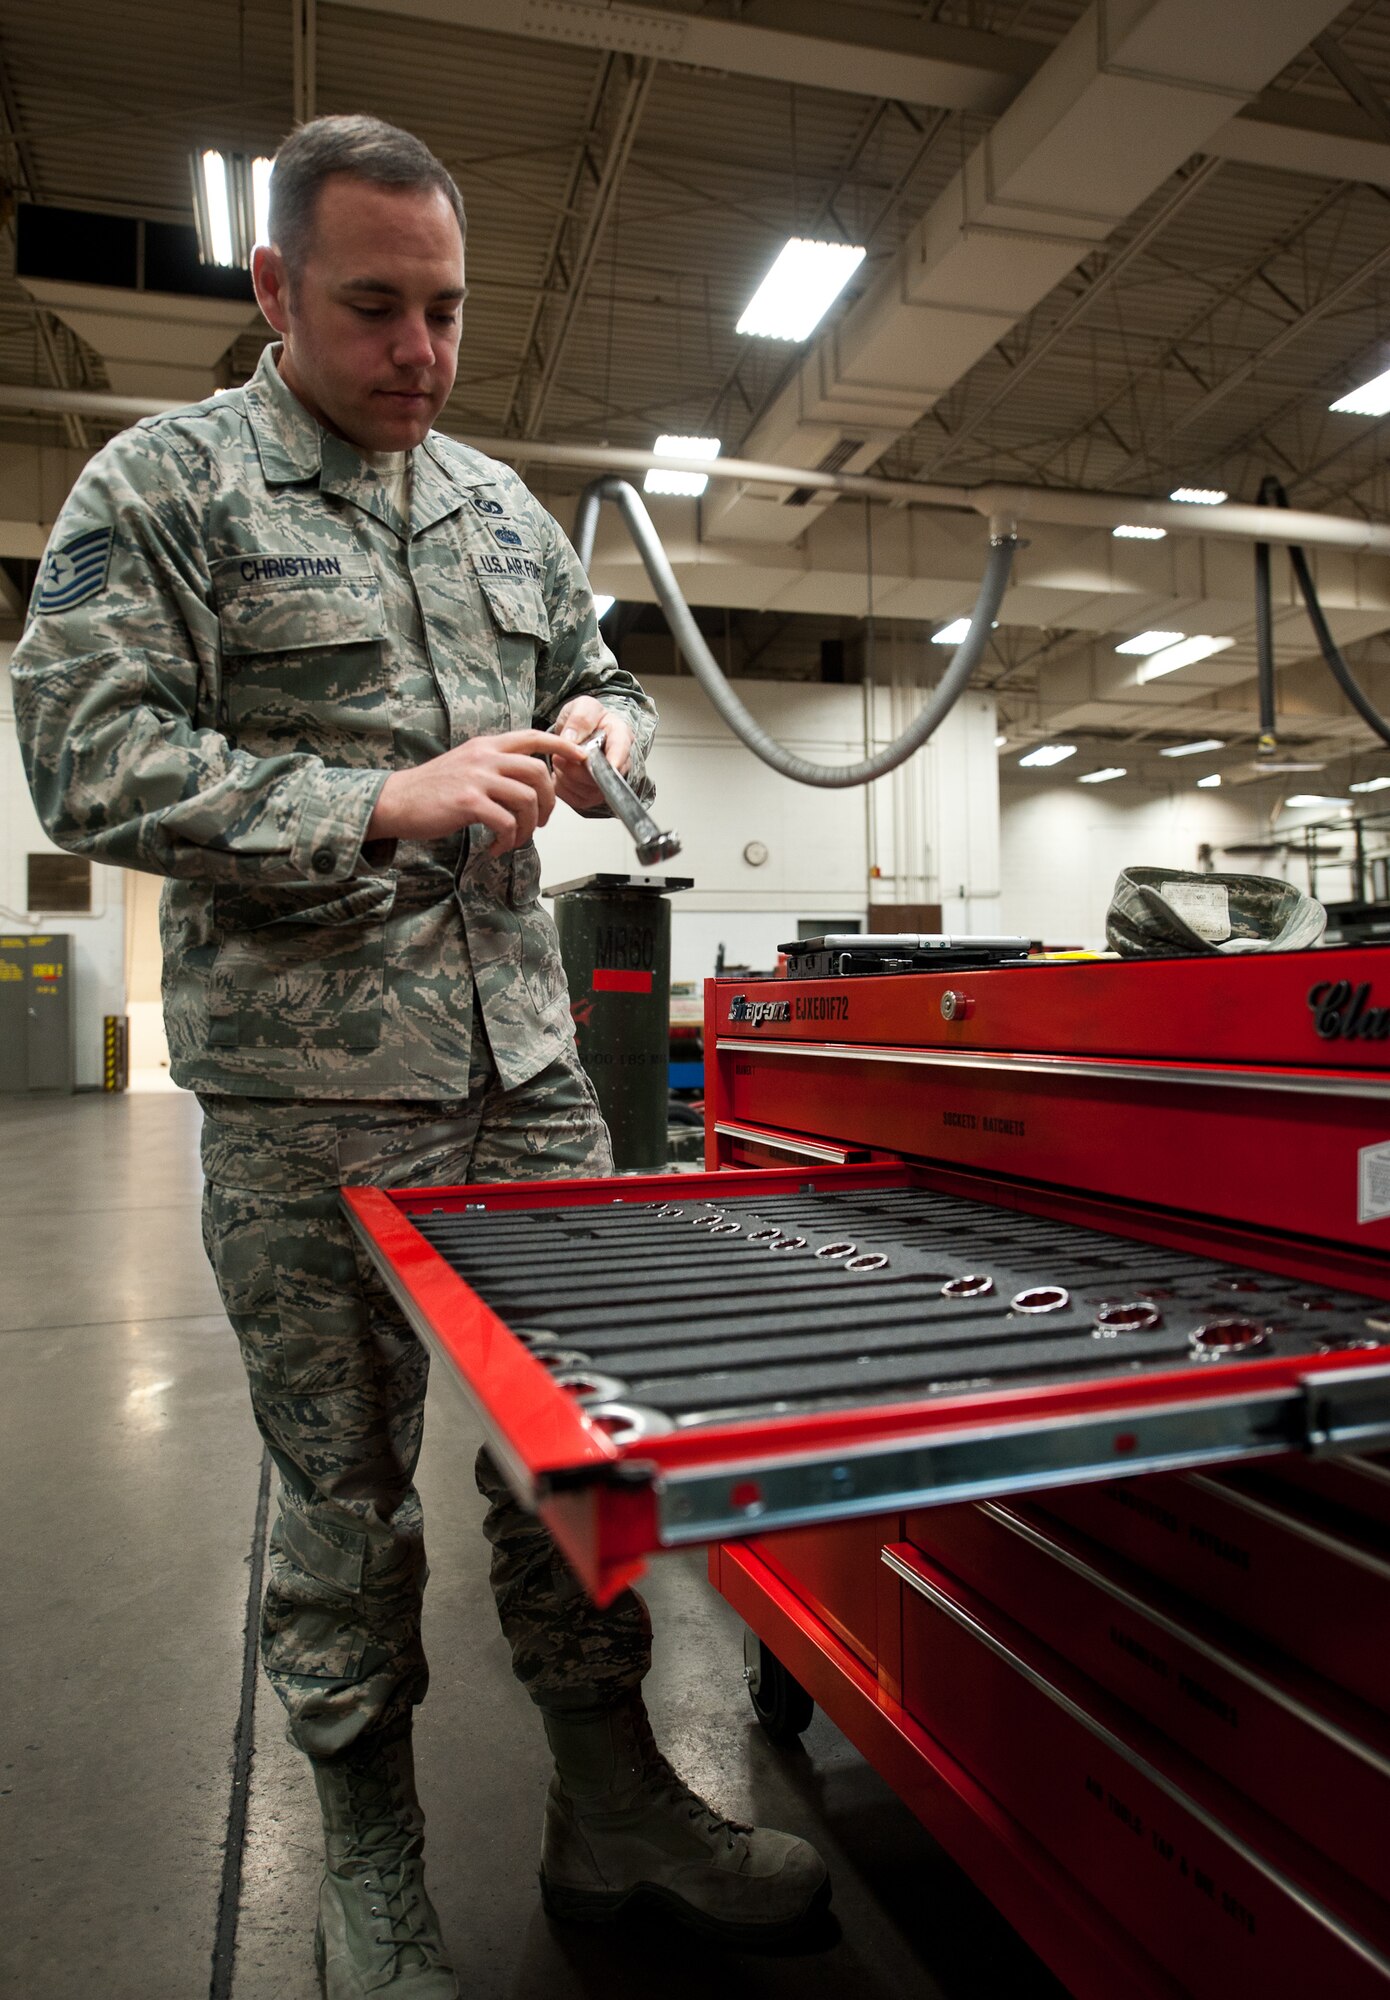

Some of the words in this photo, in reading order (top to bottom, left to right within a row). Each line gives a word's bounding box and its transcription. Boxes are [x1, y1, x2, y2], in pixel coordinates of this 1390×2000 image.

[240, 557, 341, 581] CHRISTIAN
[480, 555, 506, 574] U.S.
[505, 556, 527, 576] AIR
[728, 994, 790, 1027] Snap-on
